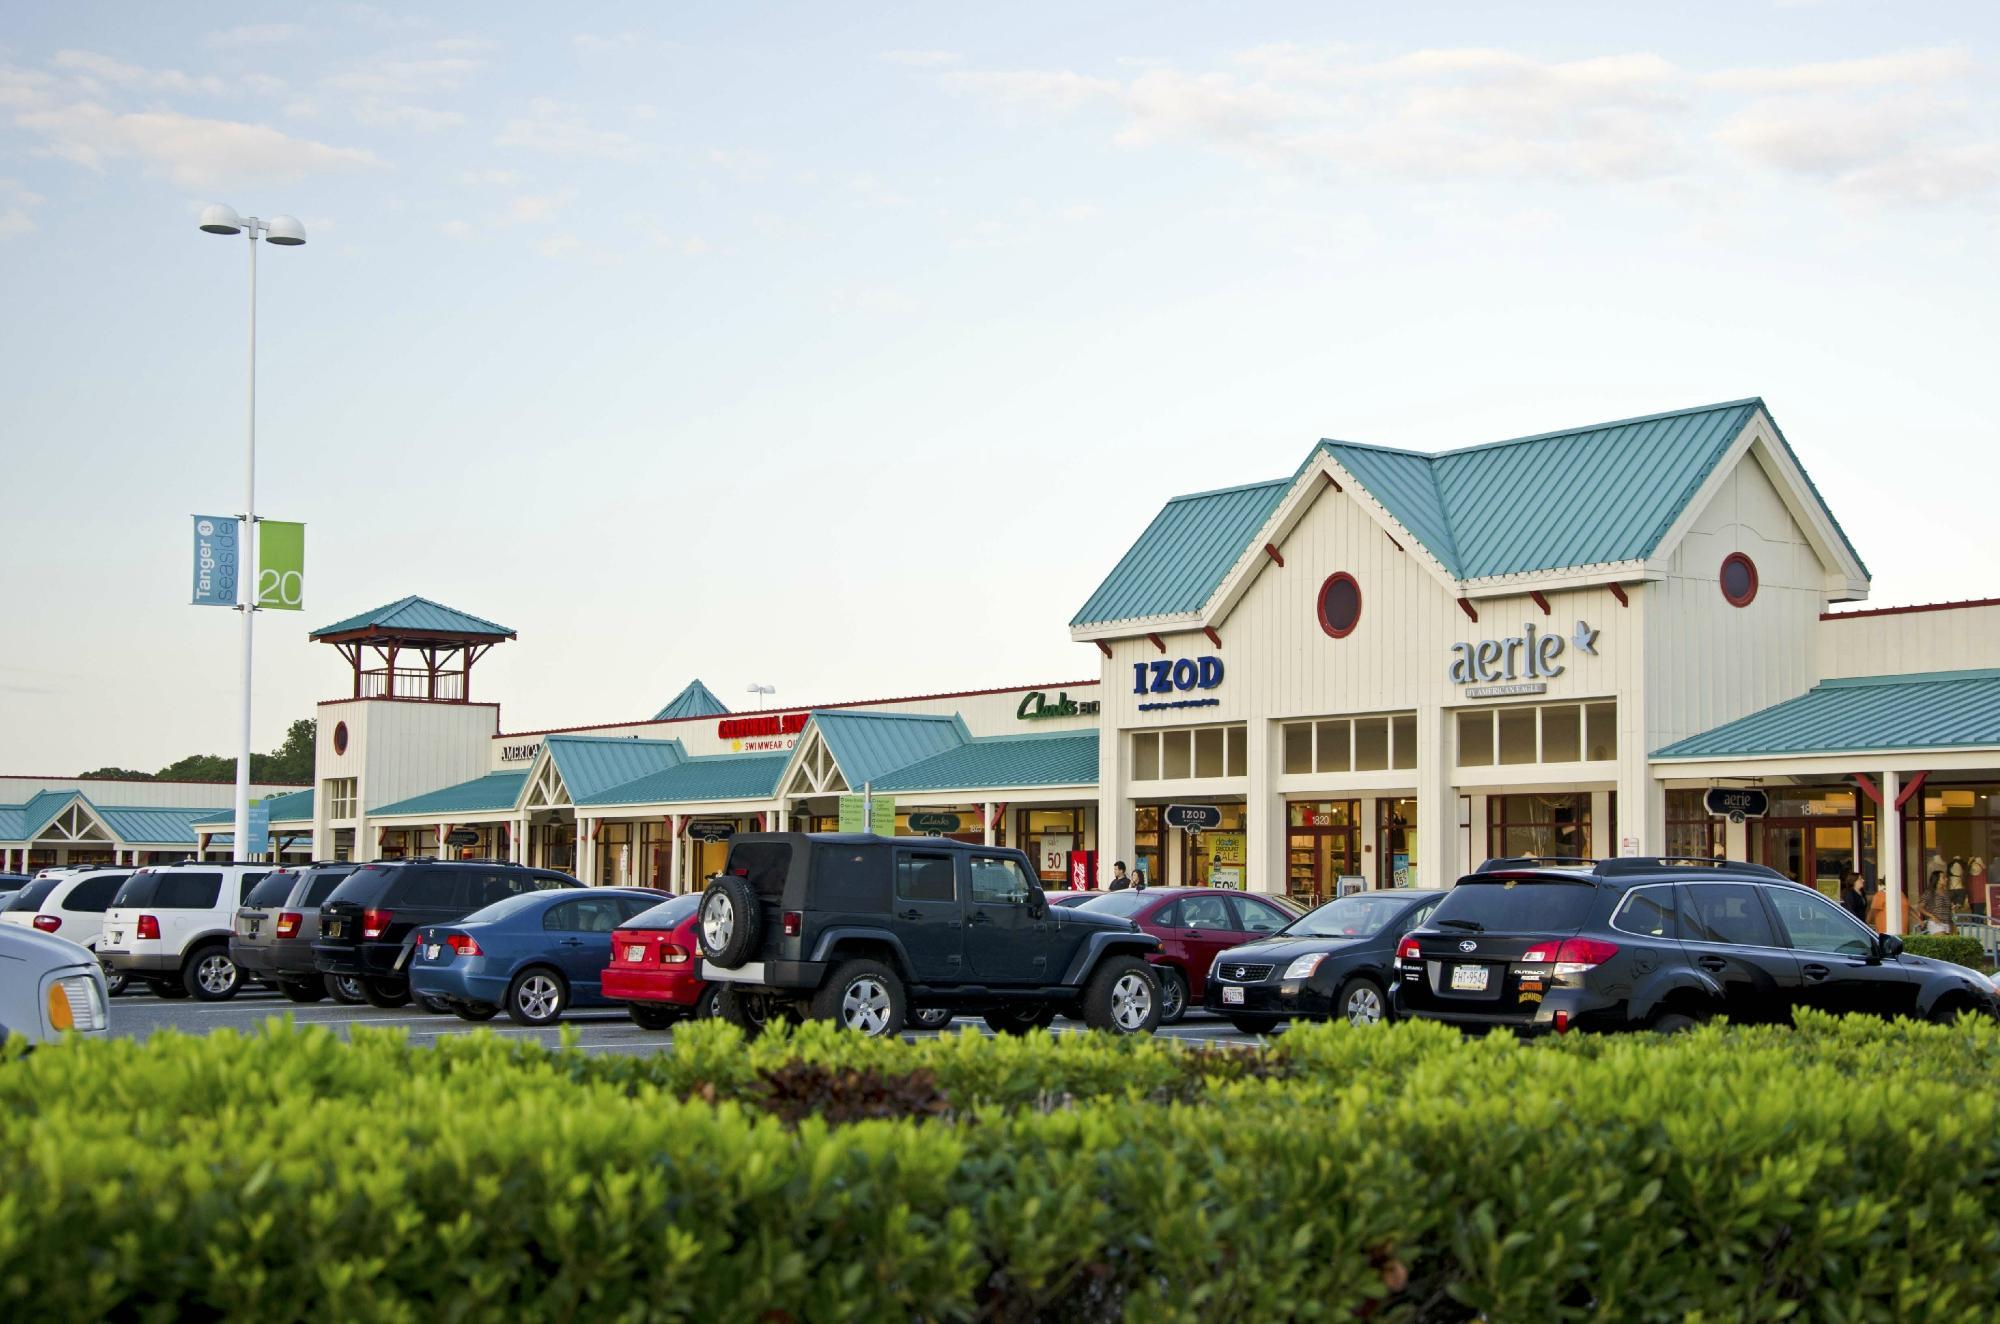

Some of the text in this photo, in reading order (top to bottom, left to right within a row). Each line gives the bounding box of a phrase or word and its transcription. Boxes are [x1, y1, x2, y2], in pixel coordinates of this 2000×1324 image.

[196, 539, 214, 600] Tanger
[215, 521, 235, 601] seaside
[259, 568, 303, 605] 20
[1448, 622, 1565, 685] aerie
[1133, 656, 1224, 695] IZOD
[1477, 686, 1516, 696] AMERICAN
[1017, 691, 1079, 720] Clarks
[745, 741, 782, 750] SWIMWEAR
[1724, 792, 1751, 807] aerie
[919, 814, 950, 826] Clarks
[1181, 810, 1206, 820] IZOD
[1047, 852, 1061, 869] 50
